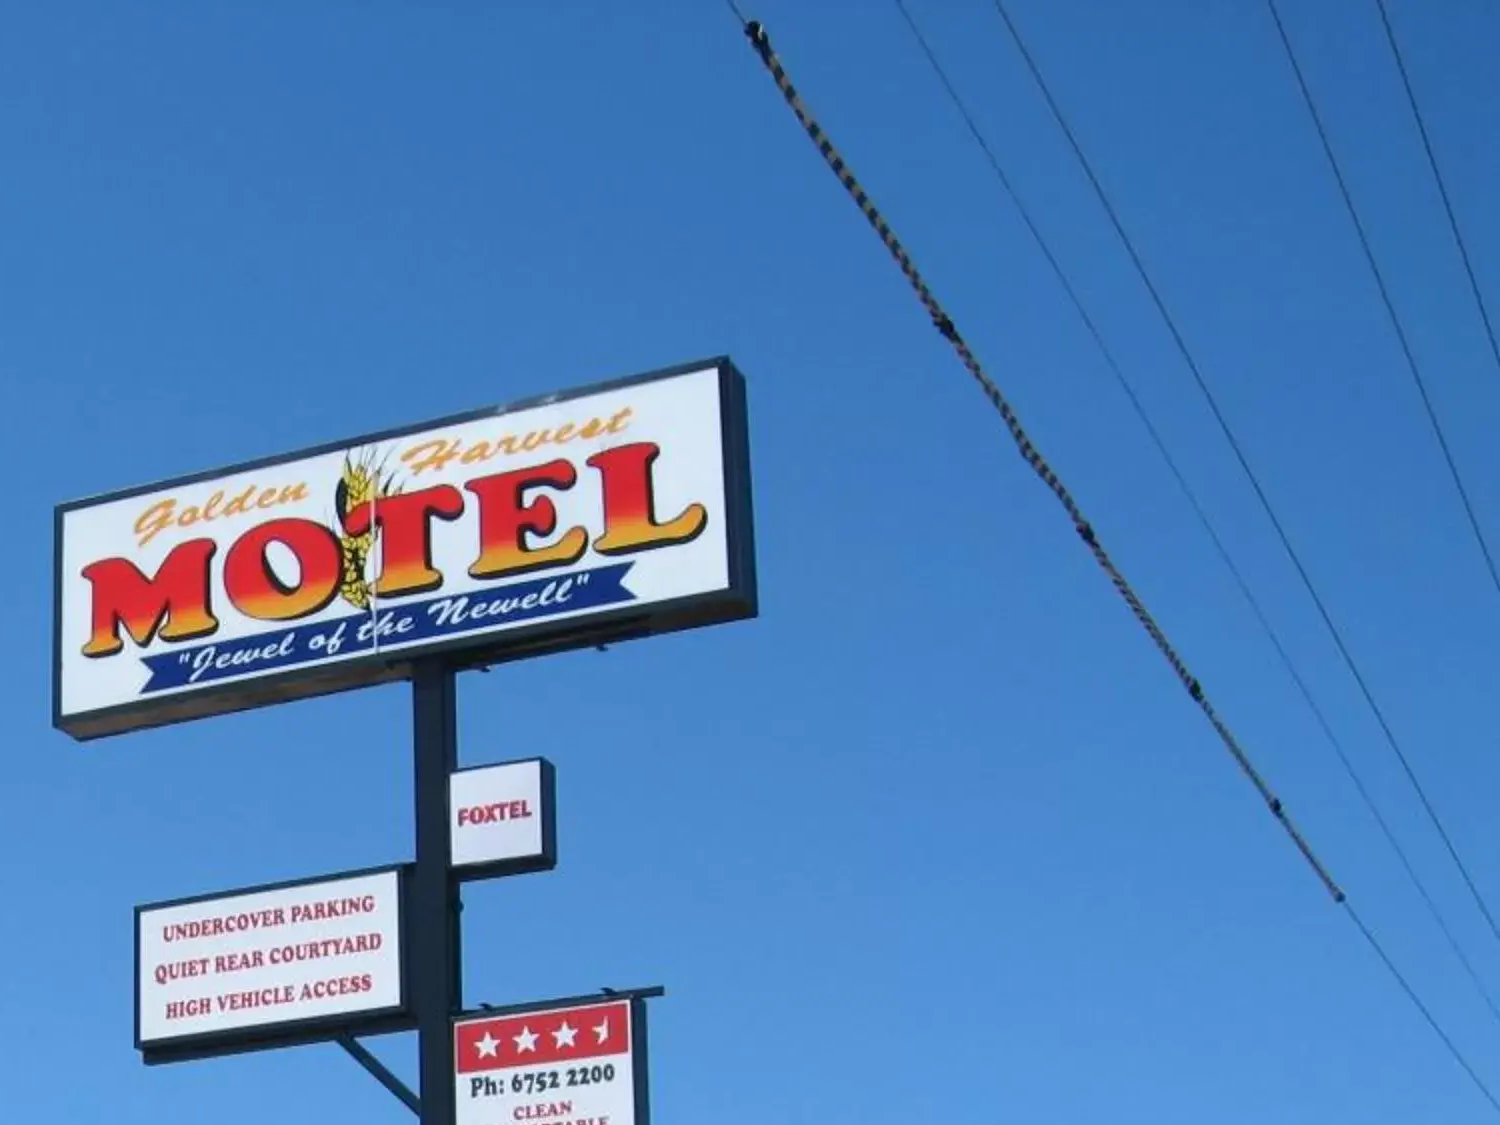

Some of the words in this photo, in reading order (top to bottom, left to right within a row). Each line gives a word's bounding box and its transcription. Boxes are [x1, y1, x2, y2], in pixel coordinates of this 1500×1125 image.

[134, 477, 308, 547] Golden
[401, 407, 632, 479] Harvest
[81, 441, 707, 658] MOTEL
[179, 633, 295, 683] "Jewel
[308, 620, 345, 656] of
[356, 610, 414, 645] the
[427, 575, 591, 628] Newell"
[458, 800, 532, 827] FOXTEL
[163, 909, 285, 942] UNDERCOVER
[291, 895, 374, 921] PARKING
[155, 960, 209, 984] QUIET
[215, 950, 263, 973] REAR
[269, 933, 382, 965] COURTYARD
[166, 998, 211, 1019] HIGH
[218, 986, 295, 1012] VEHICLE
[300, 974, 372, 1000] ACCESS
[471, 1077, 504, 1097] Ph:
[511, 1072, 560, 1094] 6752
[567, 1064, 615, 1086] 2200
[514, 1101, 572, 1120] CLEAN
